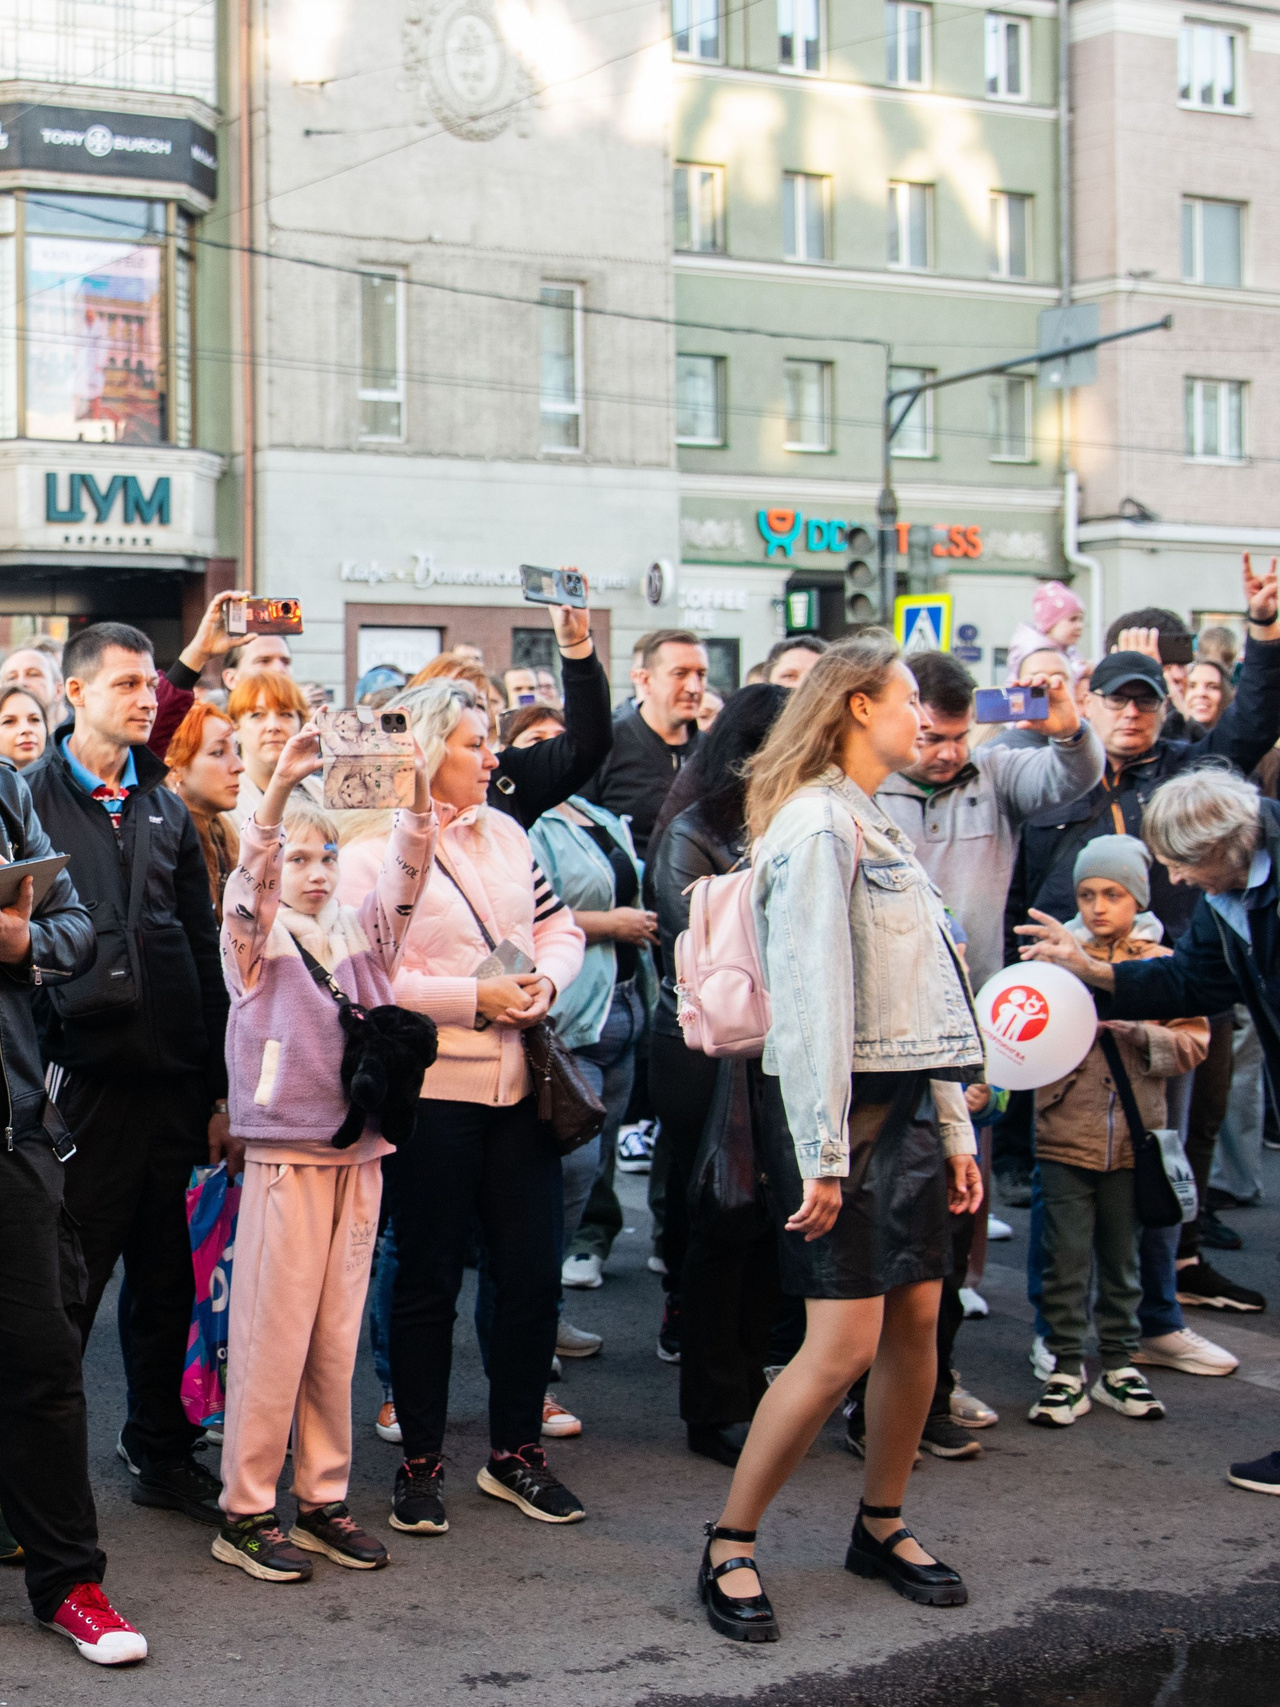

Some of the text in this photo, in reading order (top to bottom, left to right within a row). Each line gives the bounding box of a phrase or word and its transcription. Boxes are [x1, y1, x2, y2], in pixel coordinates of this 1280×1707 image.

[39, 127, 172, 155] TORY BURCH
[46, 472, 171, 525] ЦУМ
